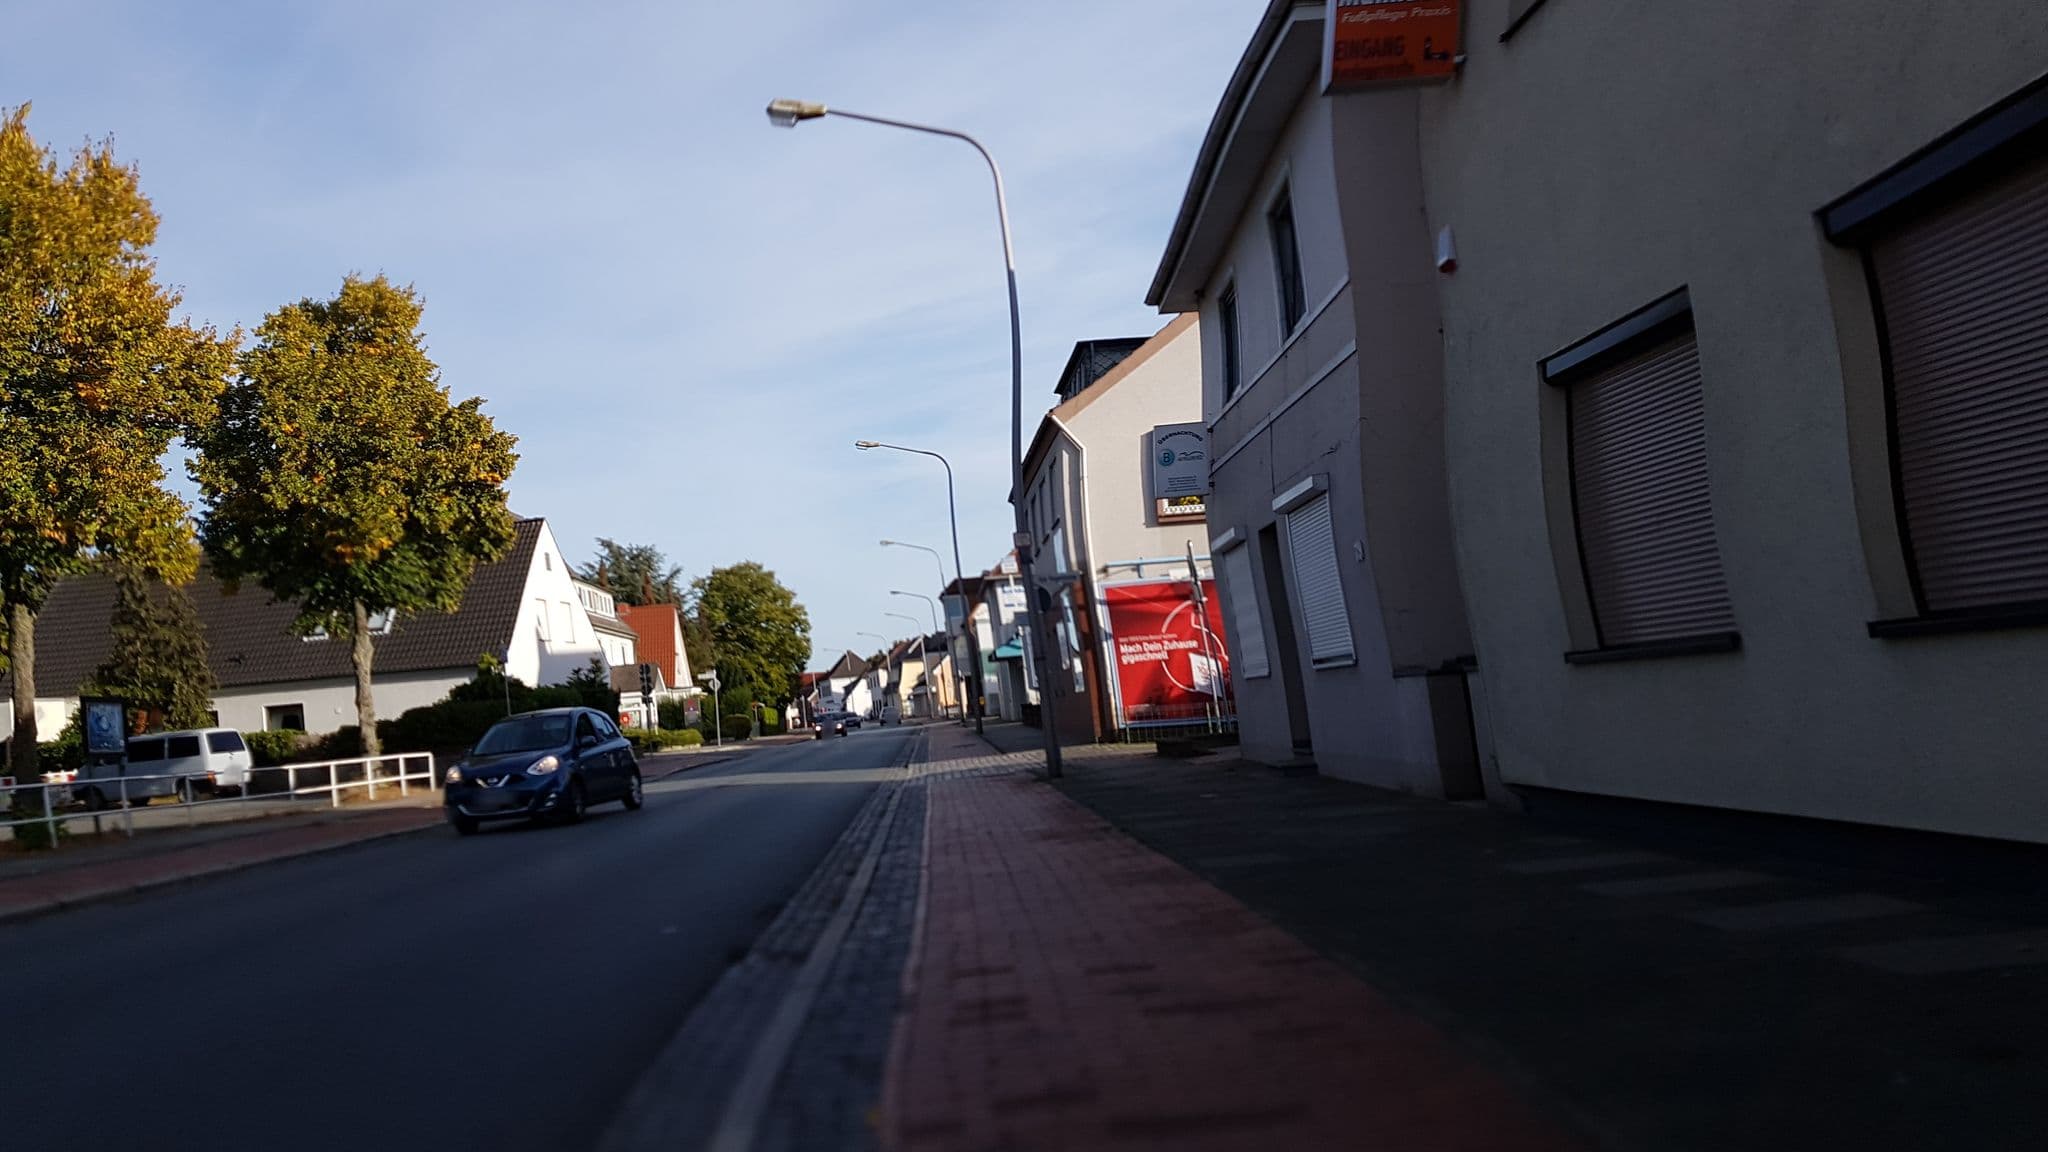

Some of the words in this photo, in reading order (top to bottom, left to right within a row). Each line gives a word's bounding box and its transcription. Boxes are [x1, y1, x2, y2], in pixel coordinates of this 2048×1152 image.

[1410, 5, 1452, 18] Praxis
[1335, 35, 1405, 60] EINGANG
[1119, 642, 1143, 654] Mach
[1142, 641, 1163, 652] Dein
[1162, 639, 1199, 651] Zuhause
[1121, 650, 1169, 665] gigaschnell
